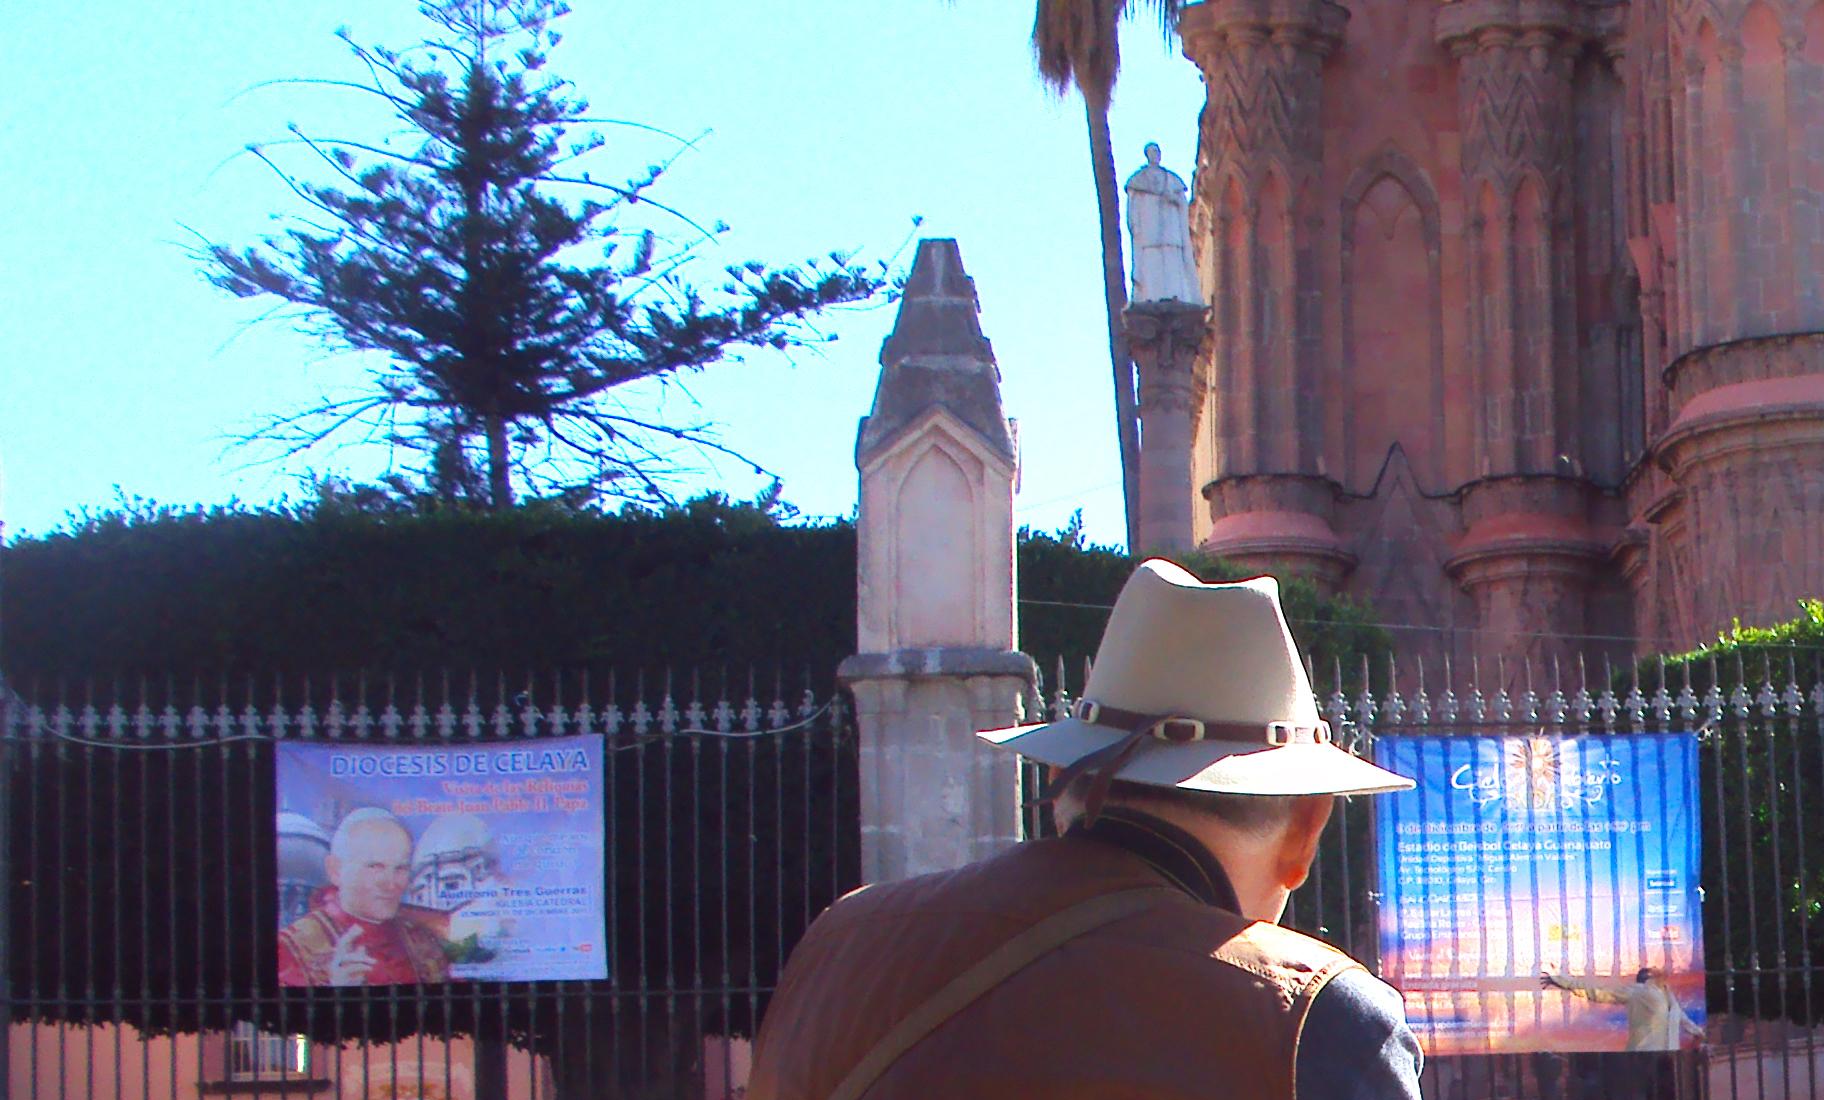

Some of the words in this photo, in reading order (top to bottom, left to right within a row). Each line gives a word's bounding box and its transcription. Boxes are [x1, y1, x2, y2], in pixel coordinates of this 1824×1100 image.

[330, 754, 447, 776] DIOCESIS
[454, 752, 487, 774] DE
[493, 749, 589, 773] CELAYA
